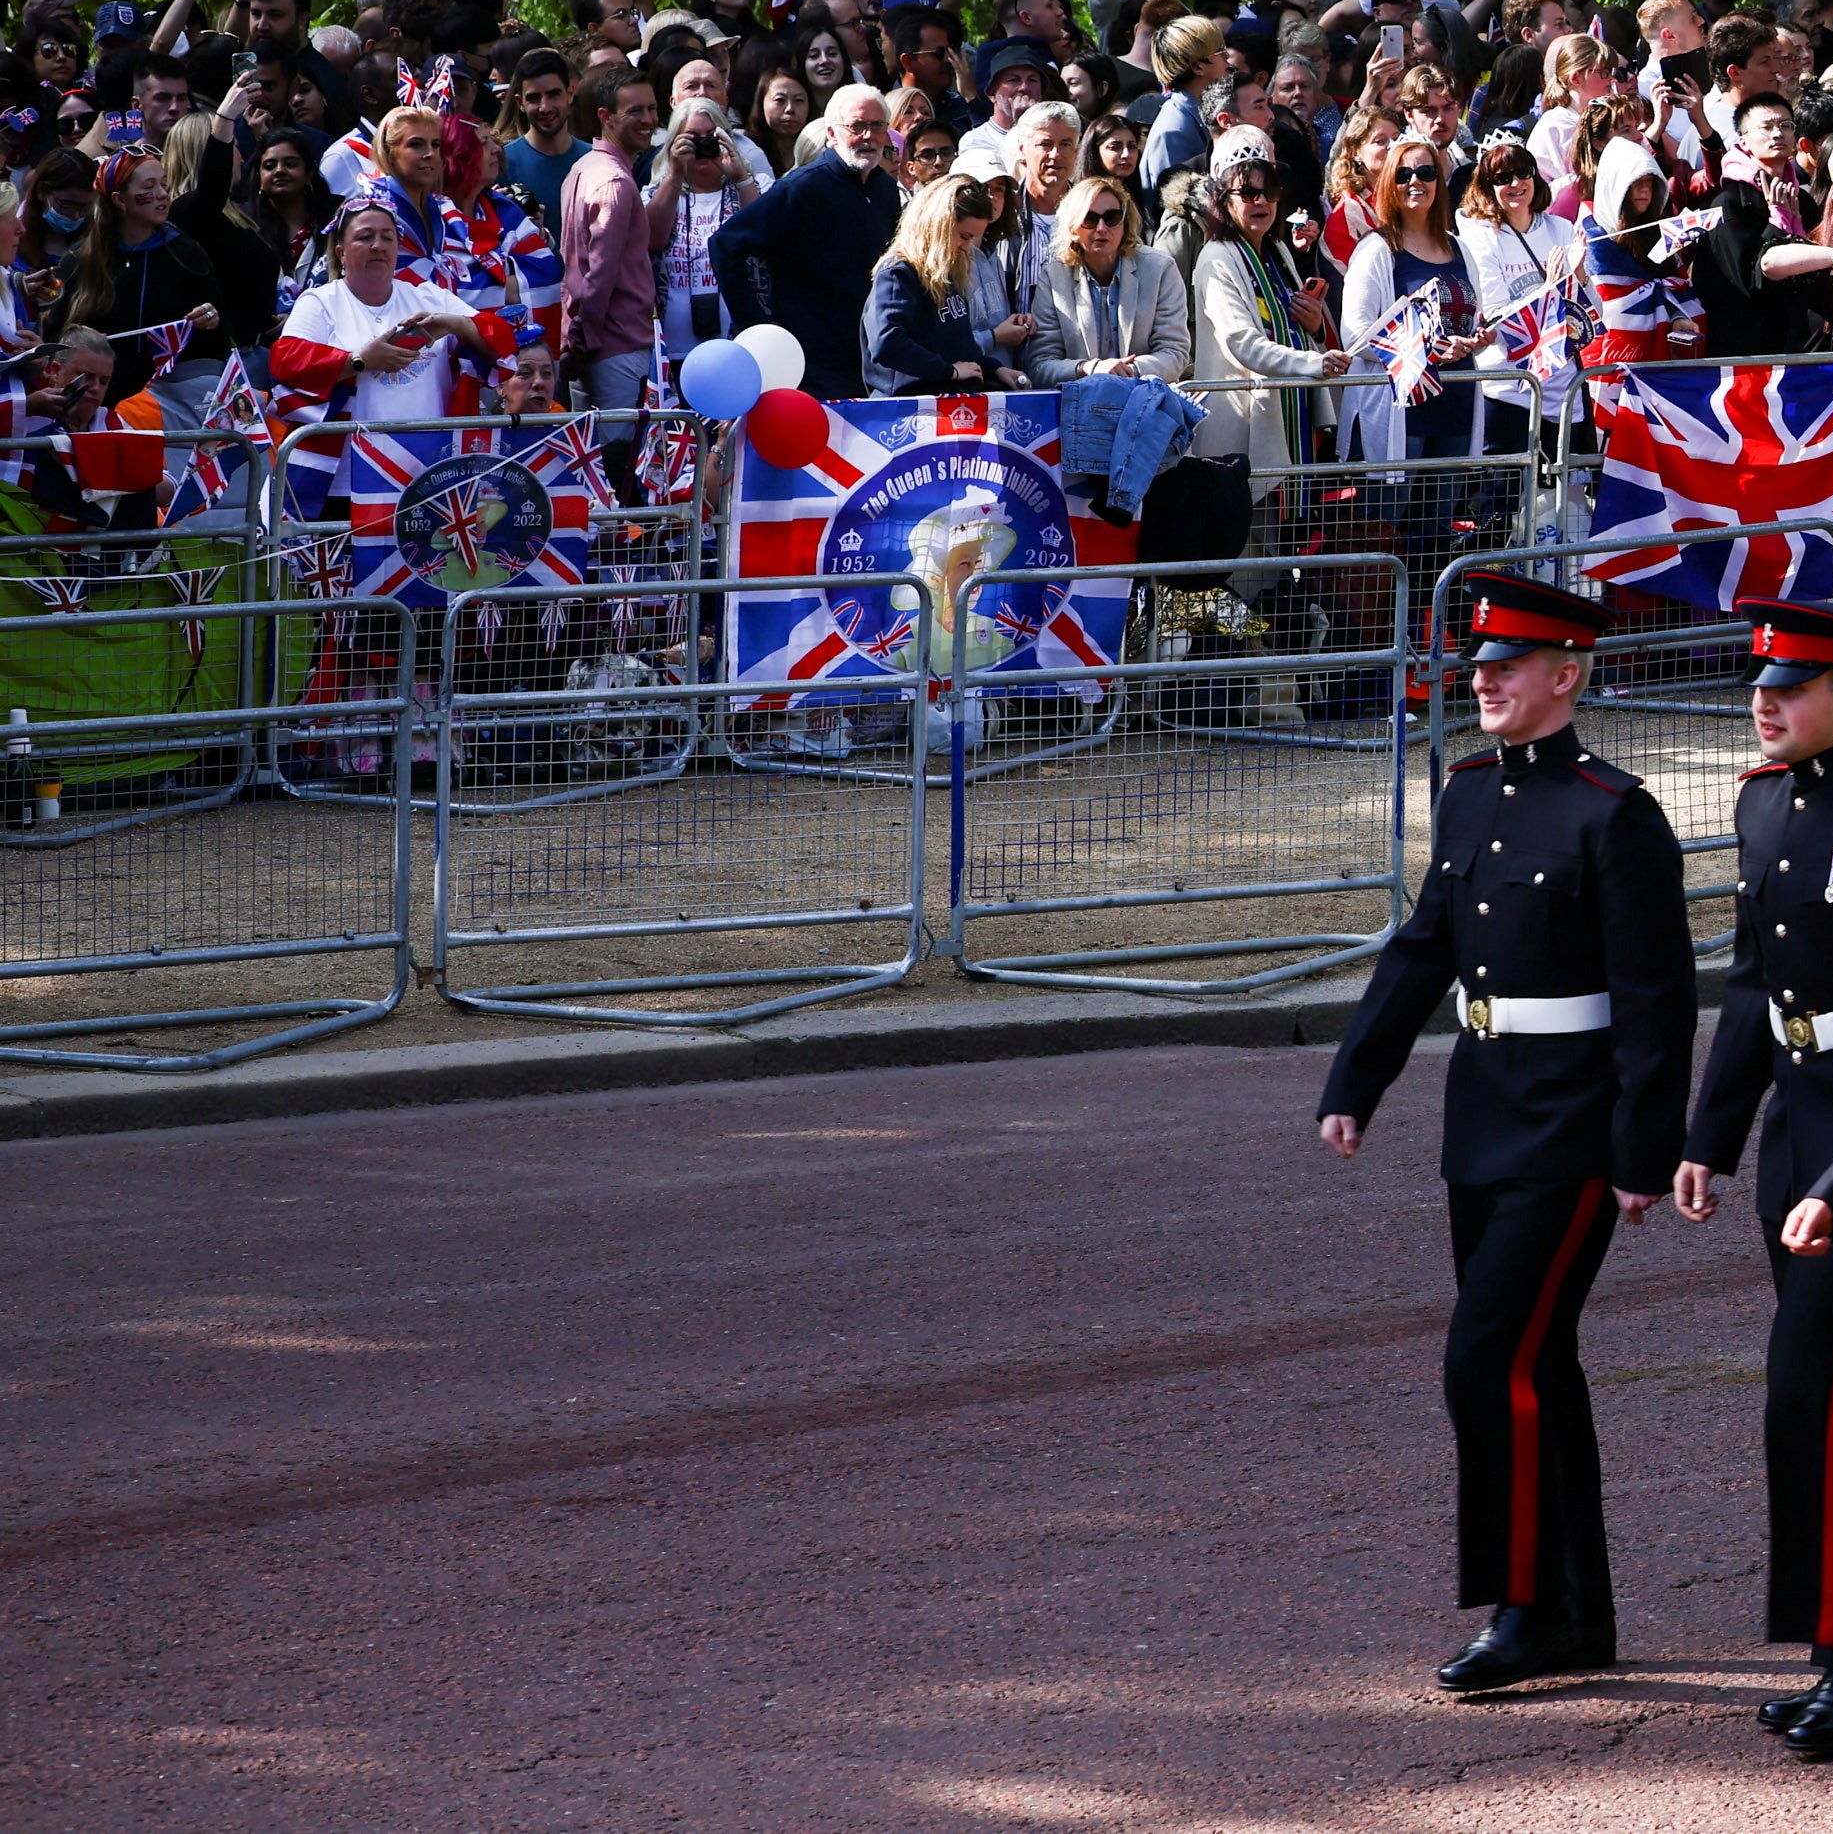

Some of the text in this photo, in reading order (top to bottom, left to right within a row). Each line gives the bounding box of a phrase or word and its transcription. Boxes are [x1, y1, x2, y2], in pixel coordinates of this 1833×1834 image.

[861, 488, 889, 521] The
[949, 455, 1009, 486] Platinum
[404, 519, 432, 533] 1952
[512, 513, 543, 527] 2022
[830, 554, 876, 573] 1952
[1025, 548, 1070, 569] 2022
